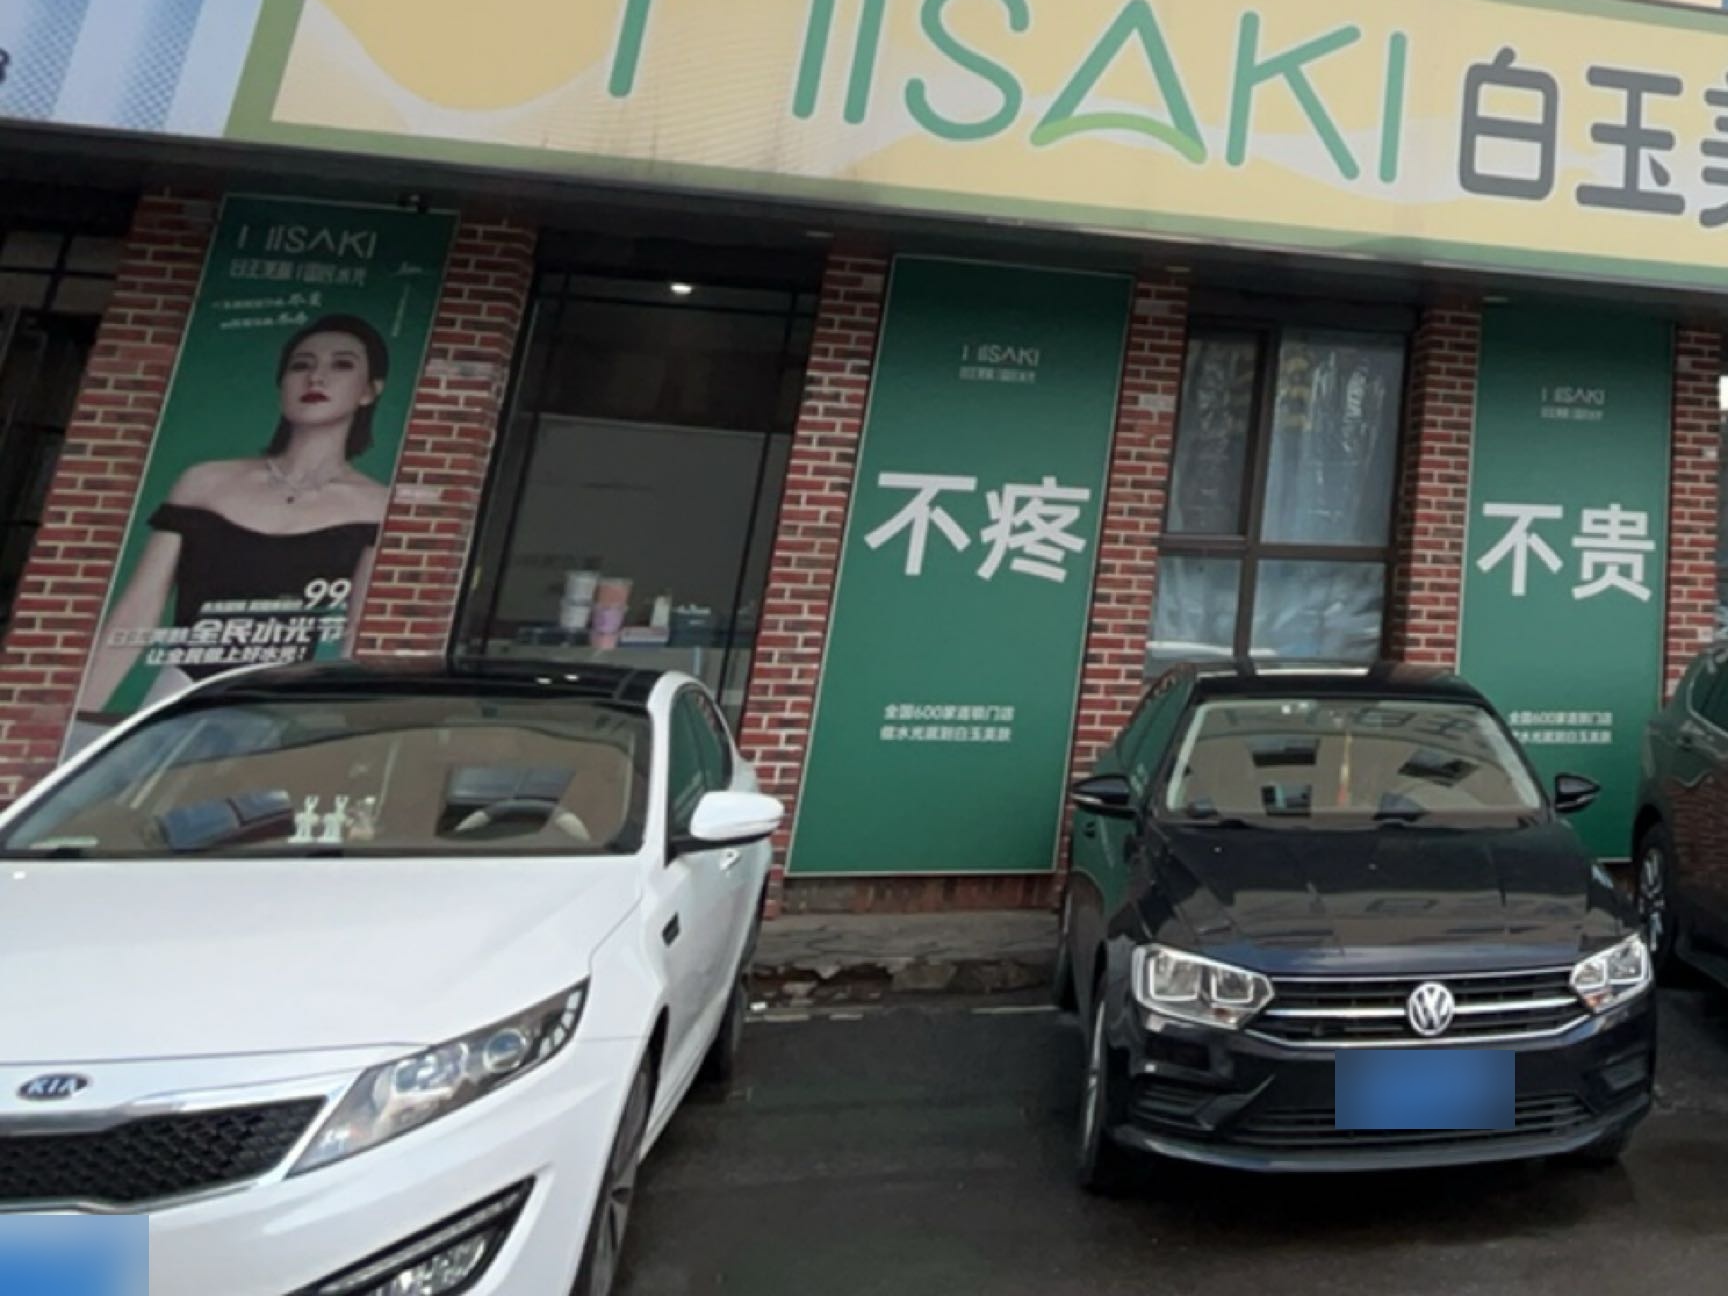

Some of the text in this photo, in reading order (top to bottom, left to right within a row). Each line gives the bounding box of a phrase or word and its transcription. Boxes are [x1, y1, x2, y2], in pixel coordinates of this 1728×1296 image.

[864, 471, 1091, 584] 不疼
[1476, 501, 1657, 602] 不贵
[304, 577, 351, 611] 99
[24, 1076, 82, 1097] KIA
